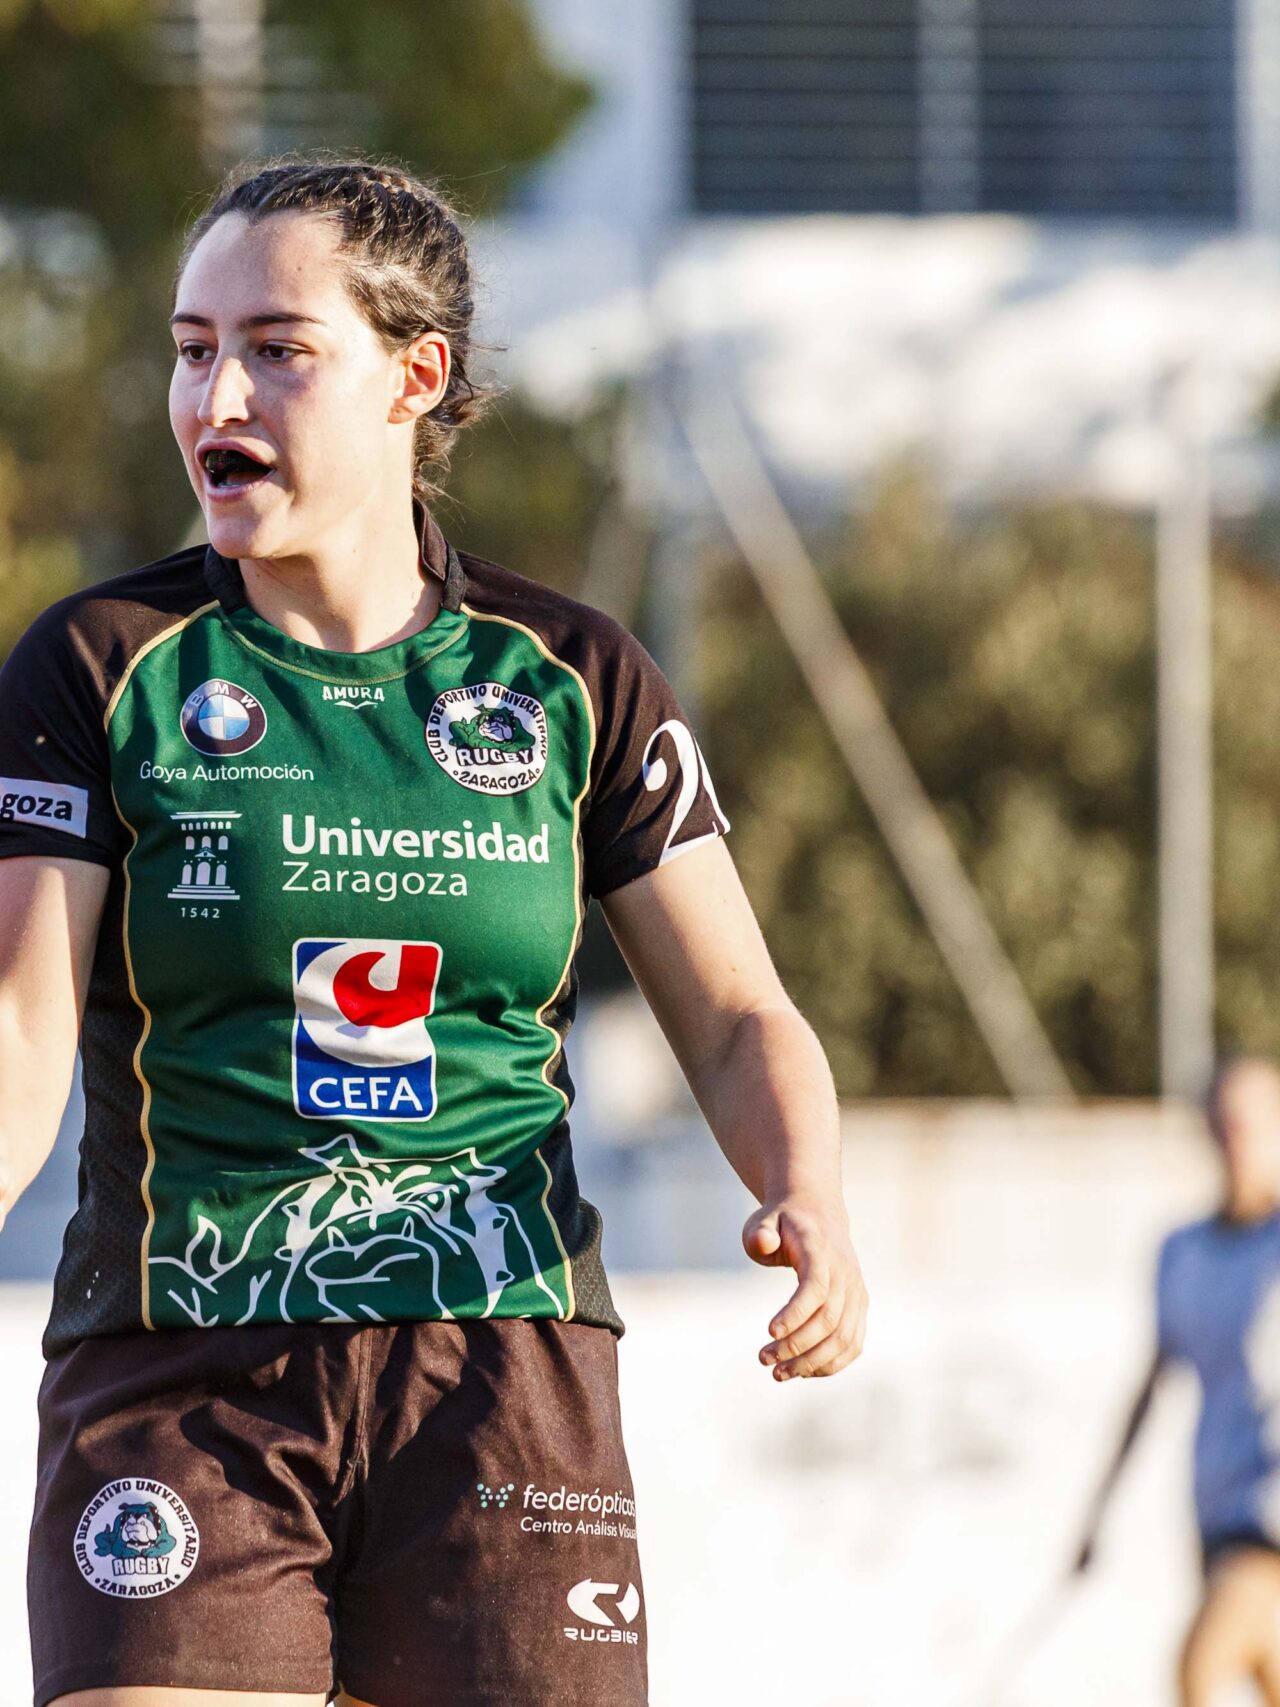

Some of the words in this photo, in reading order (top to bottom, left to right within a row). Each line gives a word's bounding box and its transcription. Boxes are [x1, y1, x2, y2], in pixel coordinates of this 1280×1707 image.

[189, 681, 258, 710] BMW
[322, 685, 385, 702] AMURA
[434, 684, 488, 726] DEPORTIVO
[428, 729, 448, 763] CLUB
[456, 748, 534, 767] RUGBY
[140, 761, 187, 783] Goya
[192, 764, 314, 781] Automoción
[458, 768, 537, 790] ZARAGOZA
[282, 814, 550, 863] Universidad
[282, 861, 468, 902] Zaragoza
[180, 906, 220, 919] 1542
[309, 1076, 423, 1112] CEFA
[77, 1480, 131, 1541] DEPORTIVO
[136, 1480, 197, 1568] UNIVERSITARIO
[520, 1516, 572, 1534] Centro
[575, 1519, 617, 1537] Análisis
[76, 1543, 94, 1576] CLUB
[112, 1557, 169, 1576] RUGBY
[99, 1577, 175, 1596] ZARAGOZA
